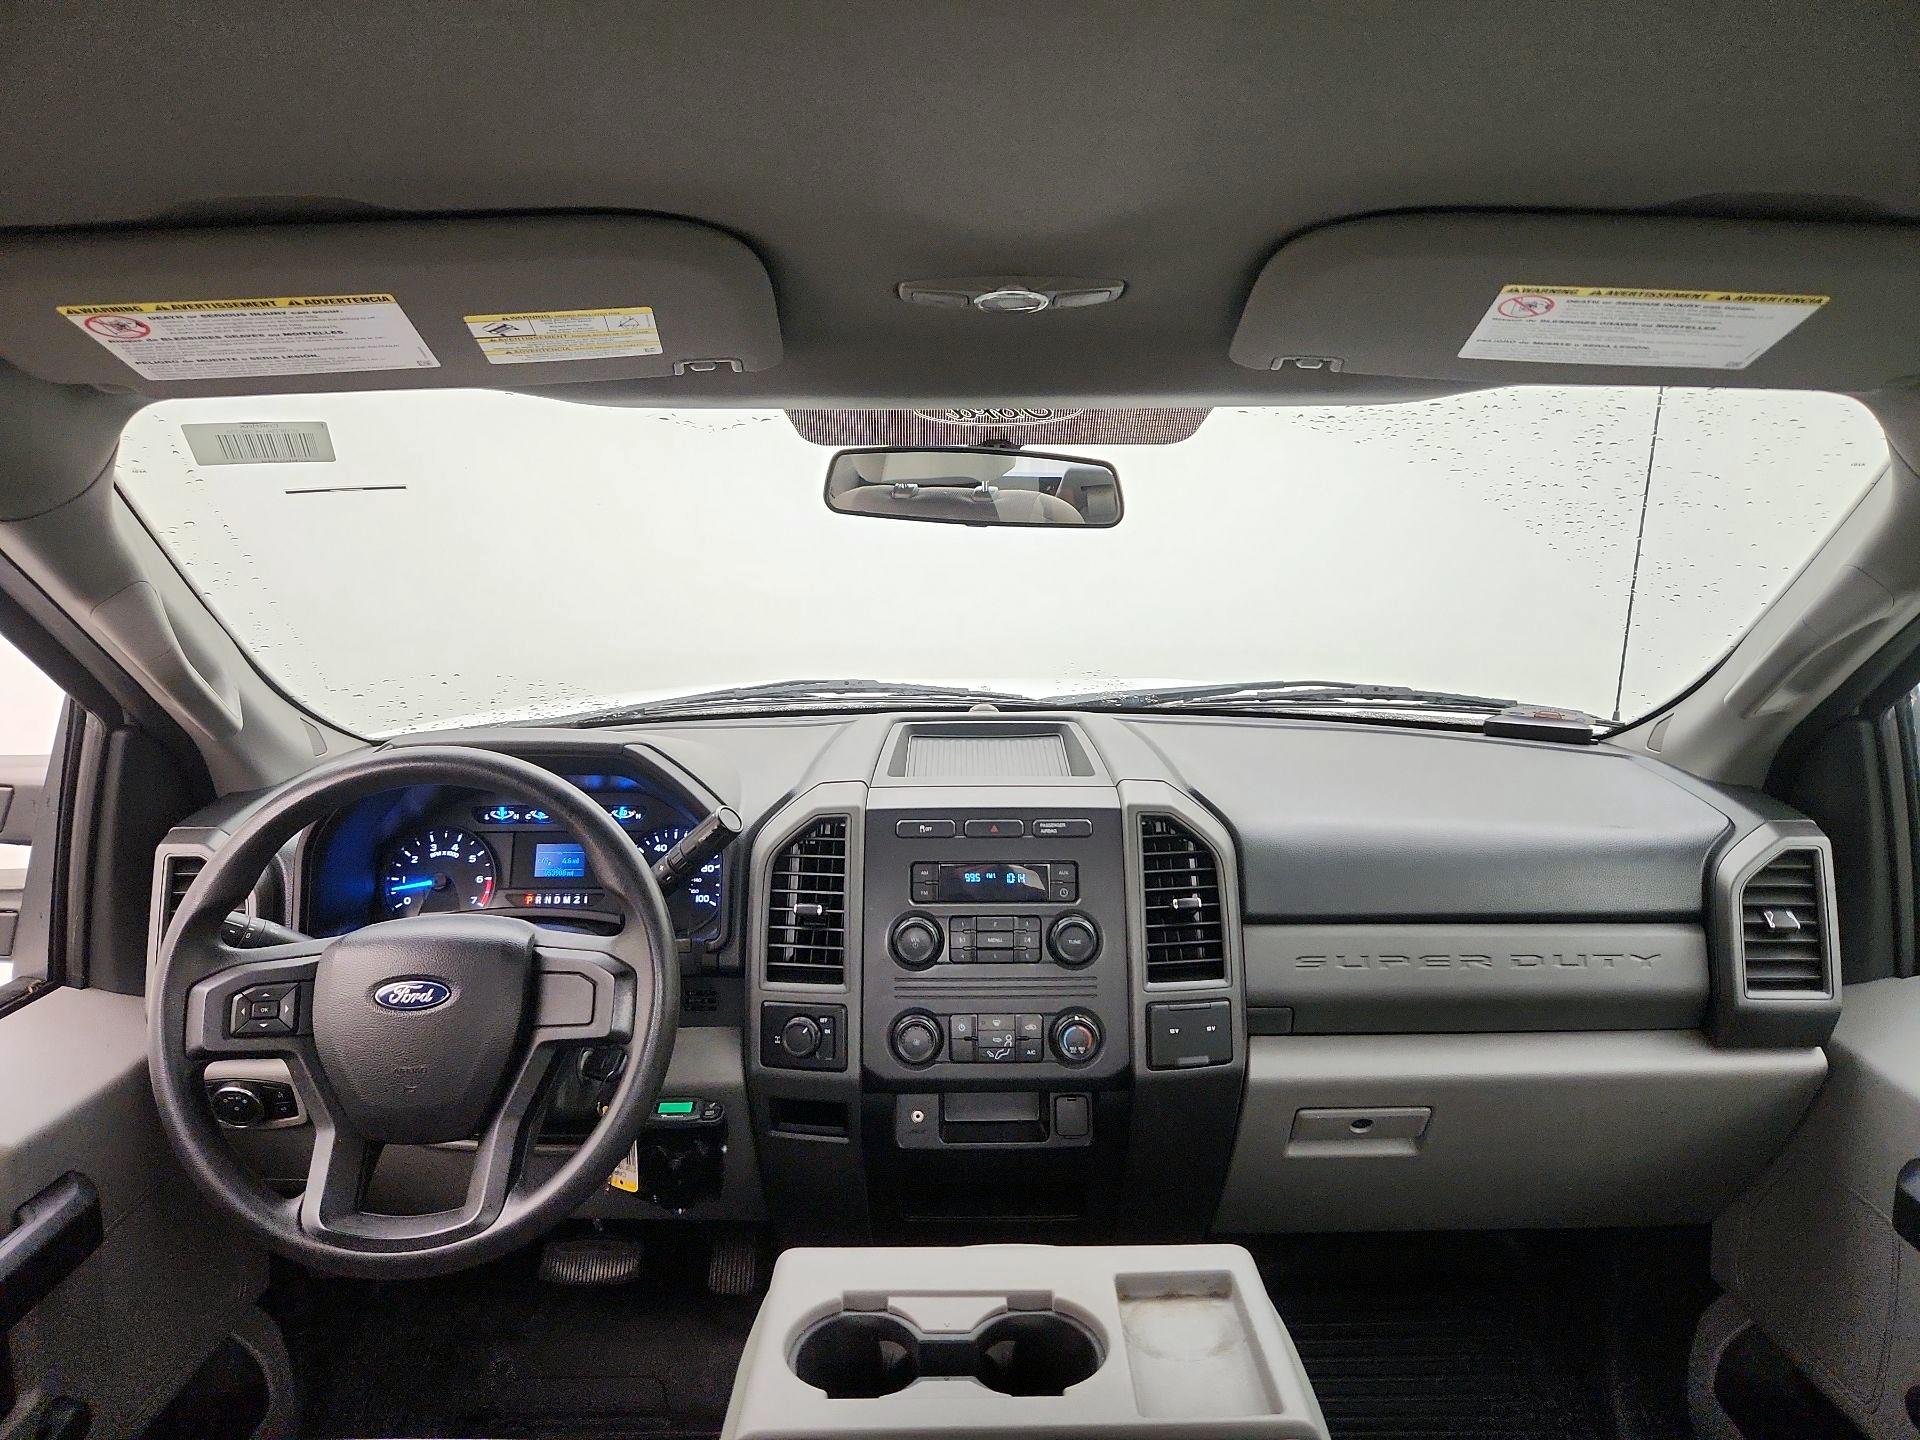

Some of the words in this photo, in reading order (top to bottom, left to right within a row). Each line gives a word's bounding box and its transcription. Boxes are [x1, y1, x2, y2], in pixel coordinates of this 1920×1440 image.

[170, 300, 277, 311] AVERTISSEMENT
[304, 296, 391, 306] ADVERTENCIA
[78, 305, 143, 315] WARNING
[430, 843, 437, 852] 3
[451, 843, 459, 851] 4
[654, 843, 668, 852] 40
[411, 855, 419, 863] 2
[468, 855, 477, 863] 5
[476, 875, 484, 883] 6
[403, 896, 412, 905] 0
[470, 896, 478, 904] 7
[526, 895, 533, 905] P
[534, 895, 542, 905] R
[543, 895, 552, 905] N
[553, 895, 561, 905] D
[563, 895, 571, 905] M
[573, 895, 581, 905] 2
[695, 894, 710, 903] 100
[1295, 954, 1492, 969] SUPER
[1509, 953, 1662, 969] DUTY
[388, 984, 435, 1004] Ford
